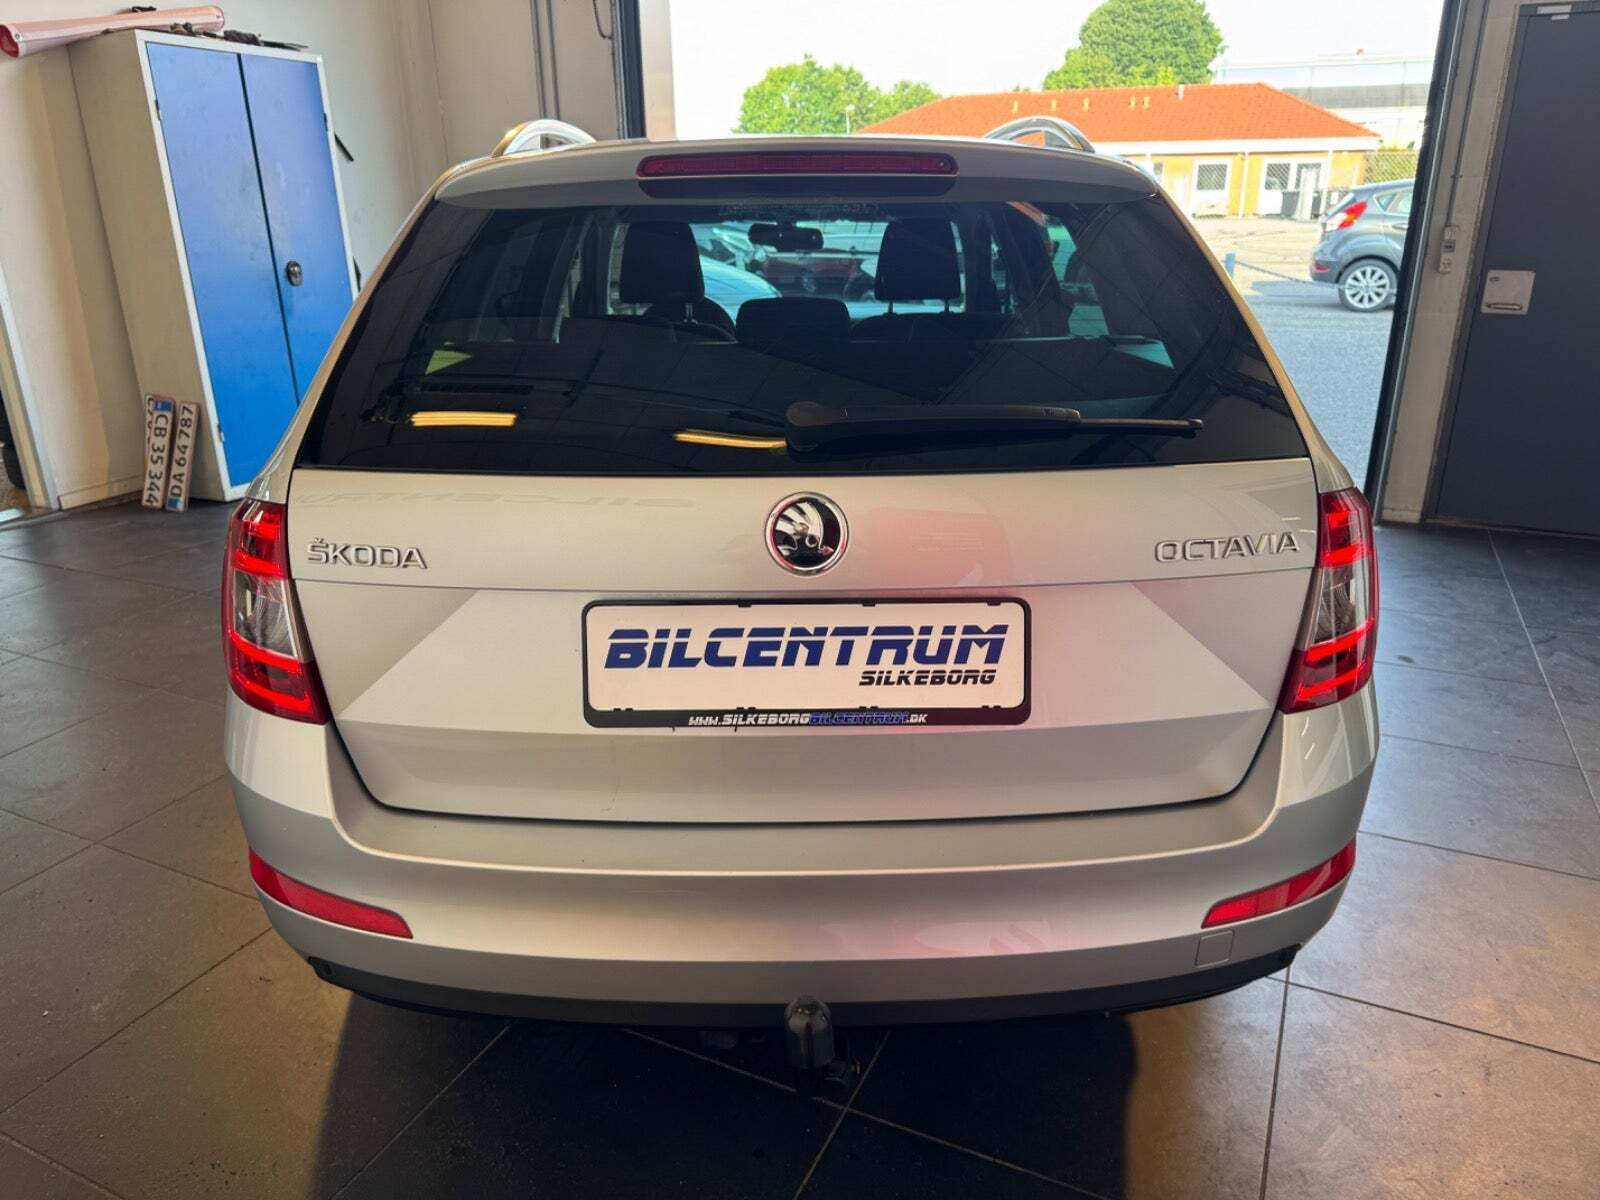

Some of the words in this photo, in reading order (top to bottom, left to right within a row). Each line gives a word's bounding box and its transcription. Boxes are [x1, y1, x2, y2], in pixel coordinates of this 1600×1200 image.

[154, 414, 168, 438] CB
[179, 405, 193, 439] 787
[151, 443, 165, 465] 35
[175, 444, 188, 467] 64
[146, 470, 162, 505] 344
[171, 473, 184, 497] DA
[307, 537, 428, 569] ŠKODA
[1155, 531, 1301, 562] OCTAVIA
[604, 624, 1009, 669] BILCENTRUM
[858, 669, 996, 686] SILKEBORG
